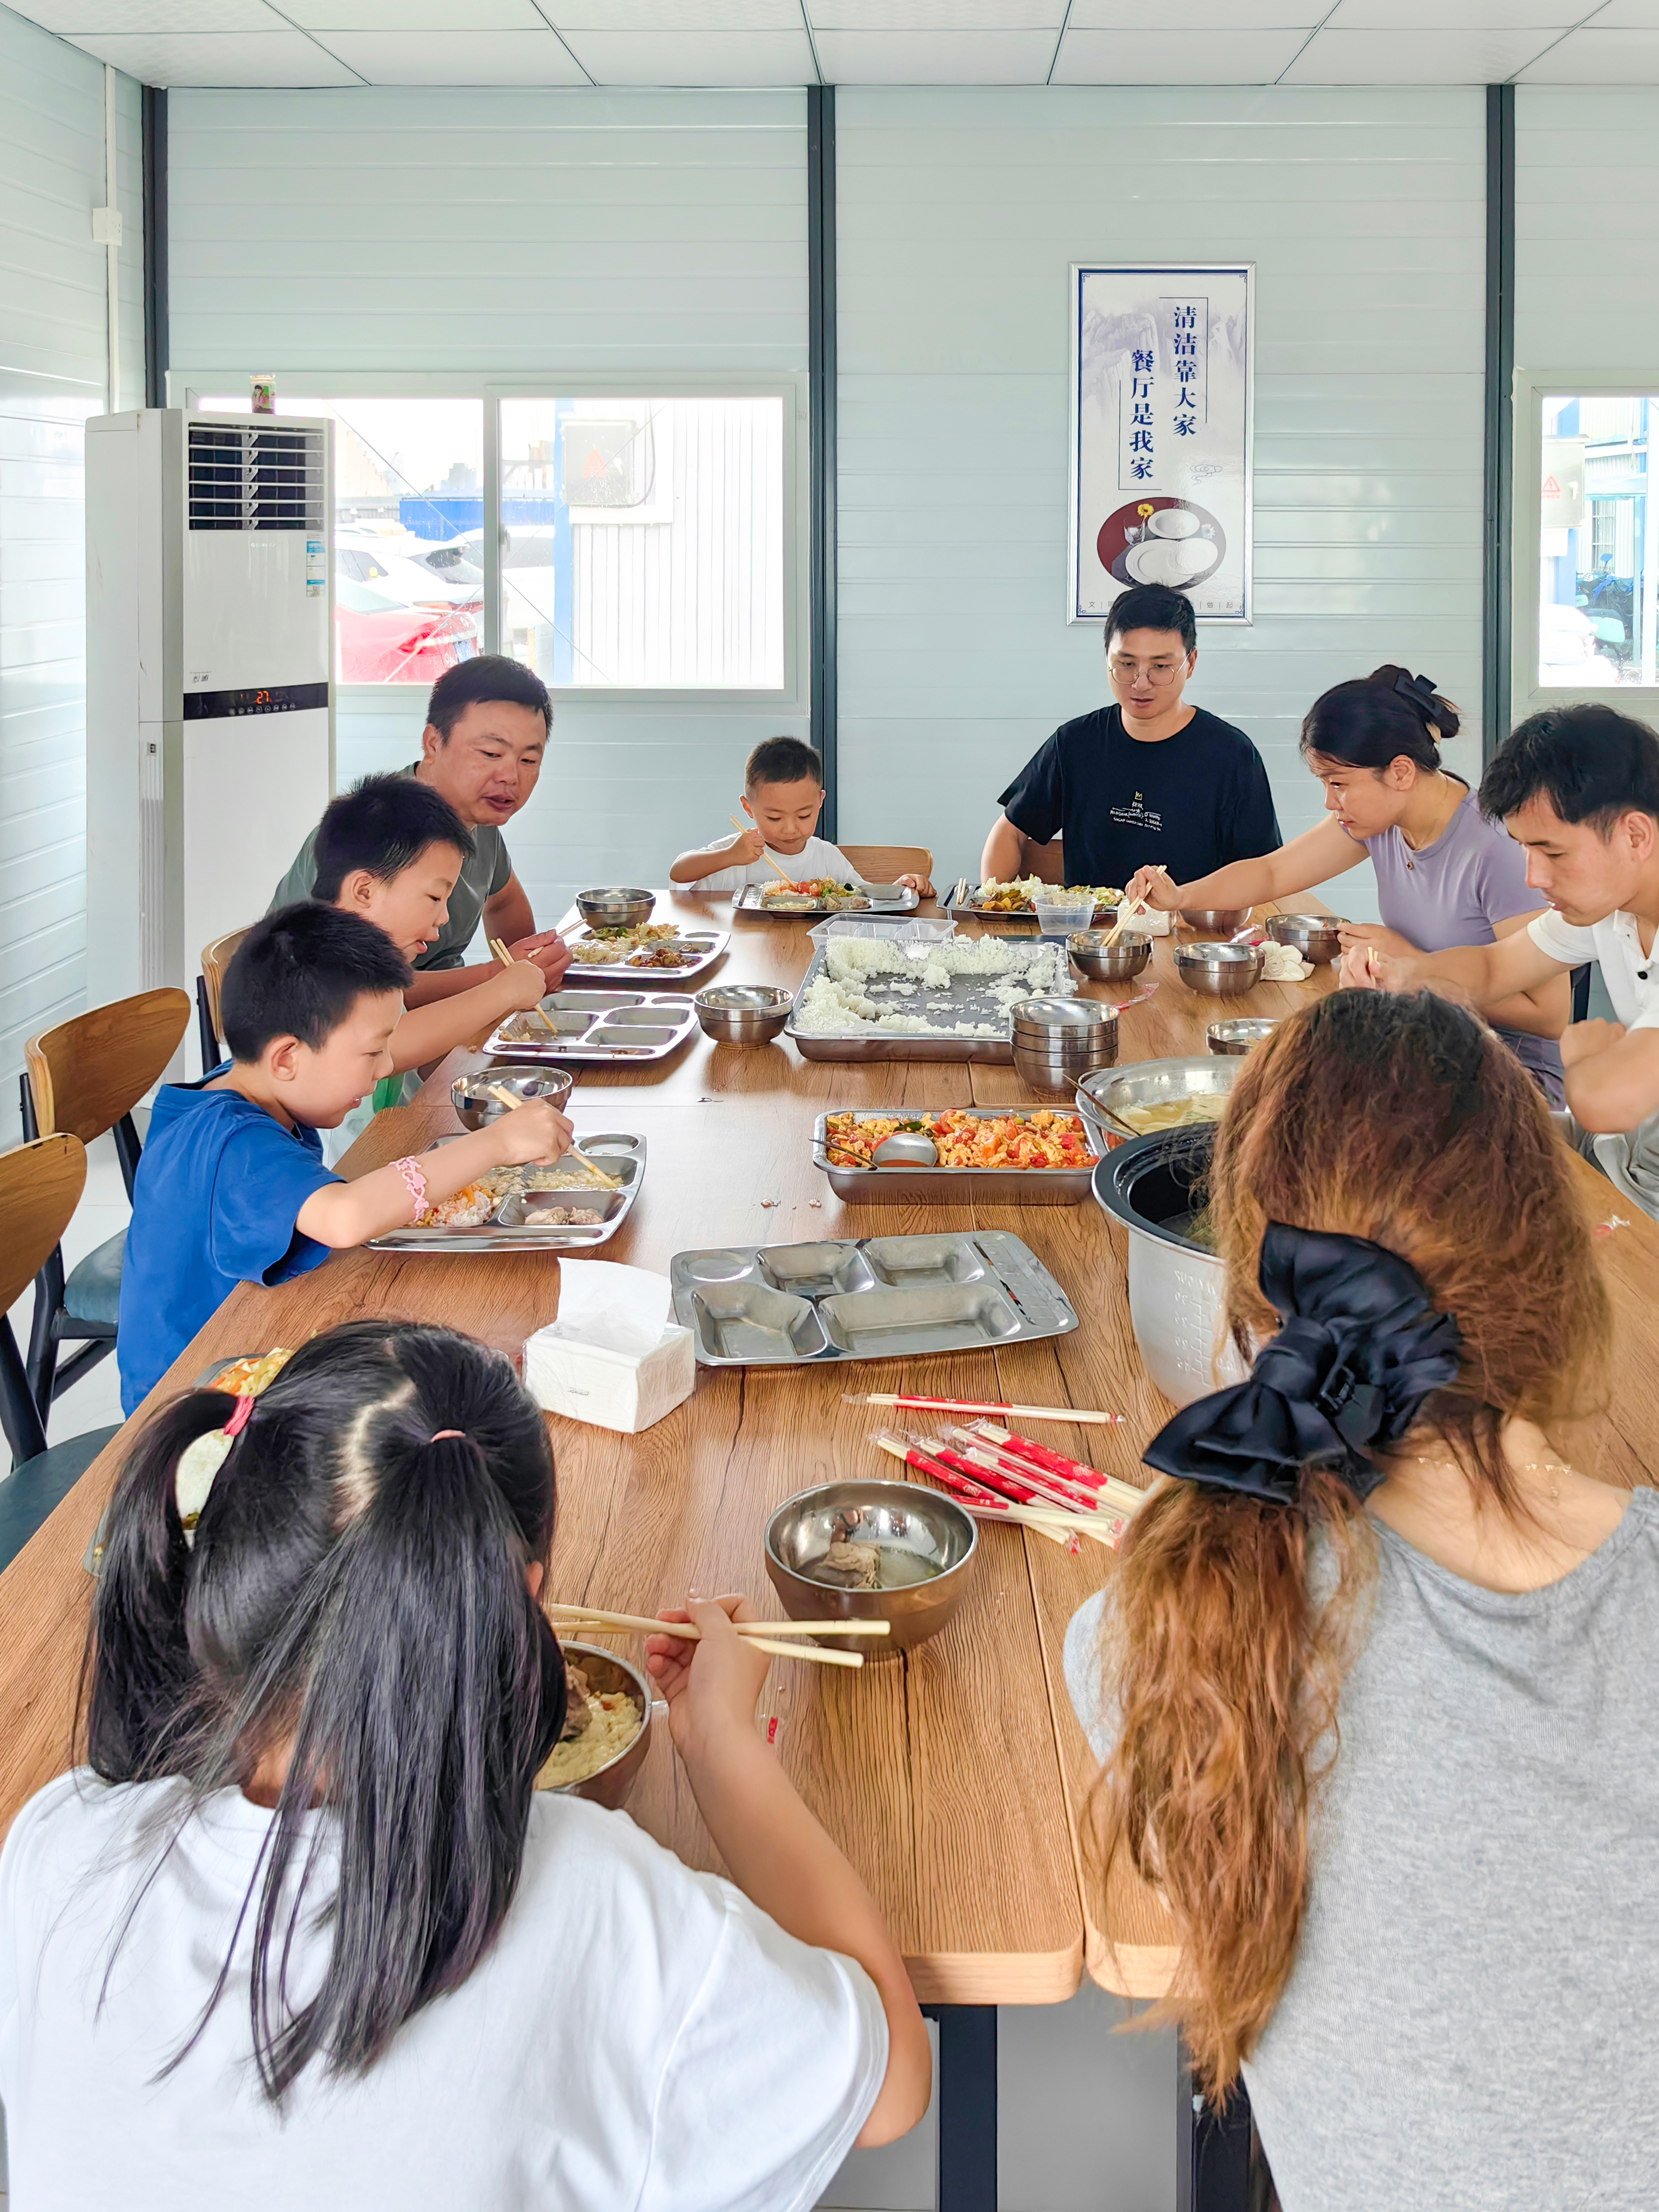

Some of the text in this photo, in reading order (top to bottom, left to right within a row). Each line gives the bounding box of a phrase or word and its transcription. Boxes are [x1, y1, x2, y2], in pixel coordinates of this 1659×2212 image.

[1129, 349, 1155, 480] 餐厅是我家
[1173, 306, 1197, 436] 清洁靠大家
[255, 691, 269, 704] 27
